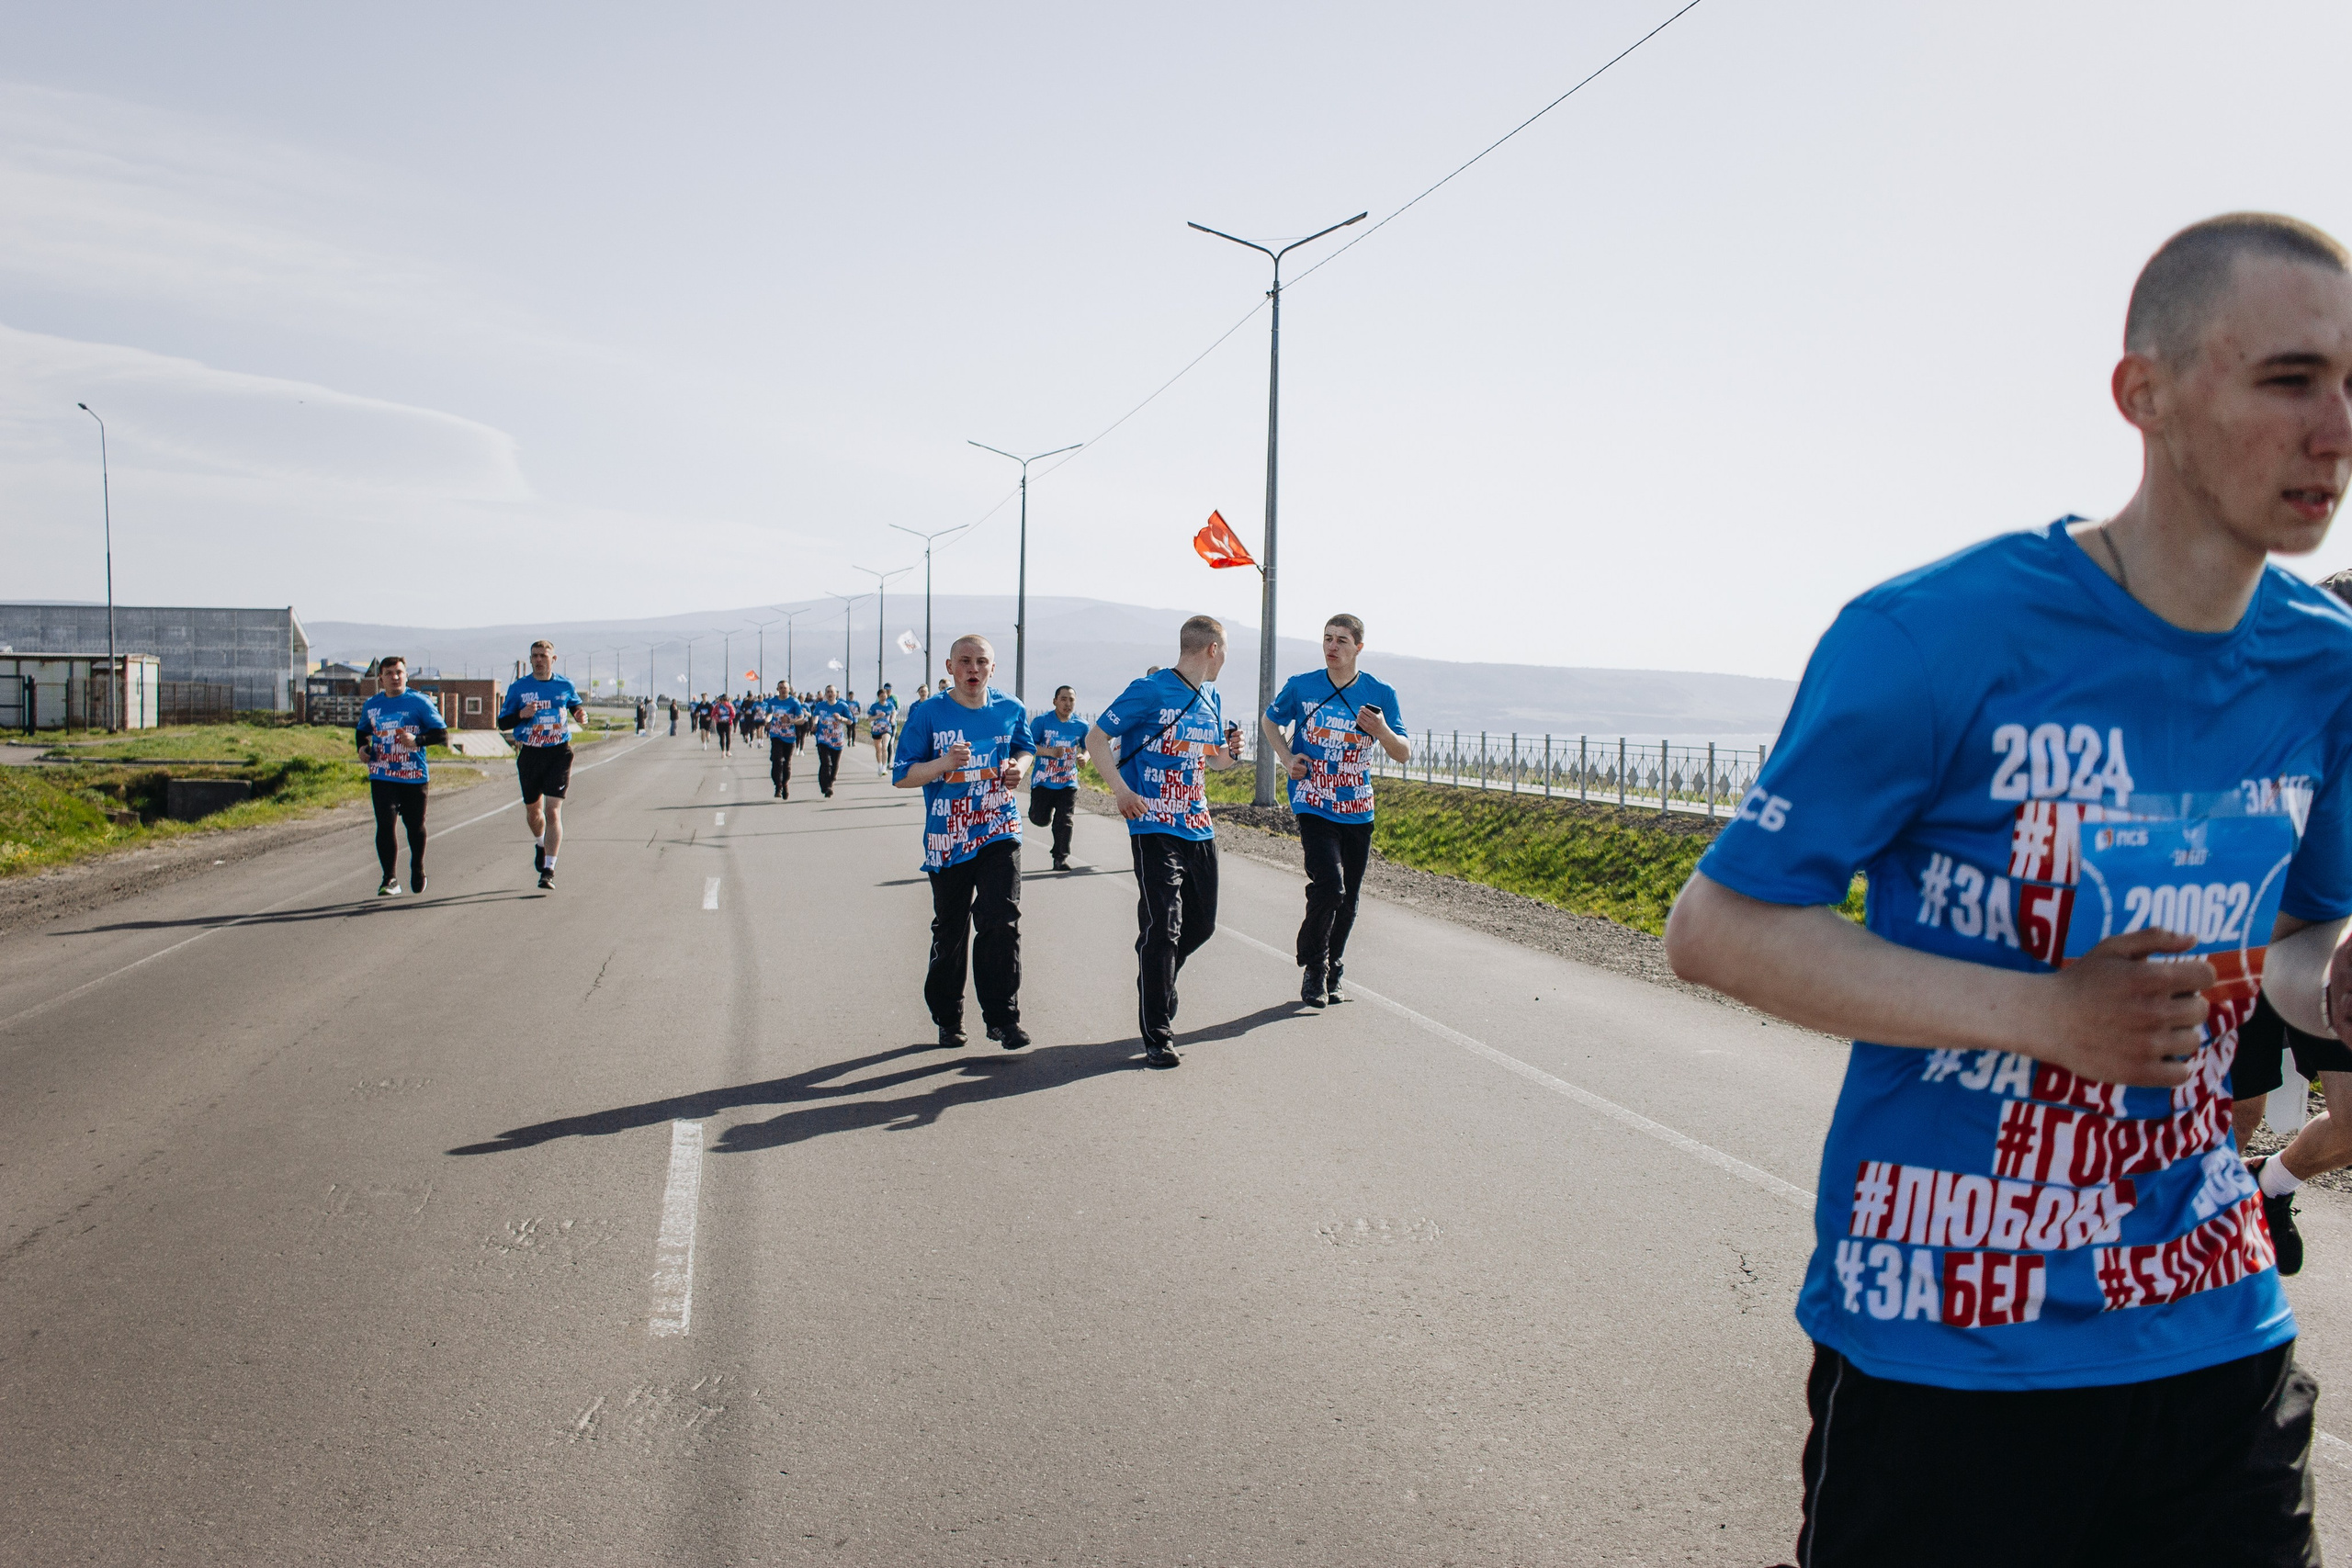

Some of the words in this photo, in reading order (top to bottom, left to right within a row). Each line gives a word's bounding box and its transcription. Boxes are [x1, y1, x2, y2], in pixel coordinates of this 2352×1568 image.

[1105, 709, 1121, 725] ПСБ
[1326, 716, 1356, 732] 20042
[1324, 748, 1362, 763] #ЗАБЕГ
[1990, 722, 2135, 808] 2024
[1310, 772, 1364, 789] #ГОРДОСТЬ
[932, 795, 972, 817] #ЗАБЕГ
[1734, 785, 1792, 832] СБ
[2123, 881, 2251, 945] 20062
[1849, 1161, 2138, 1251] #ЛЮБОВЬ
[1835, 1239, 2047, 1329] #ЗАБЕГ
